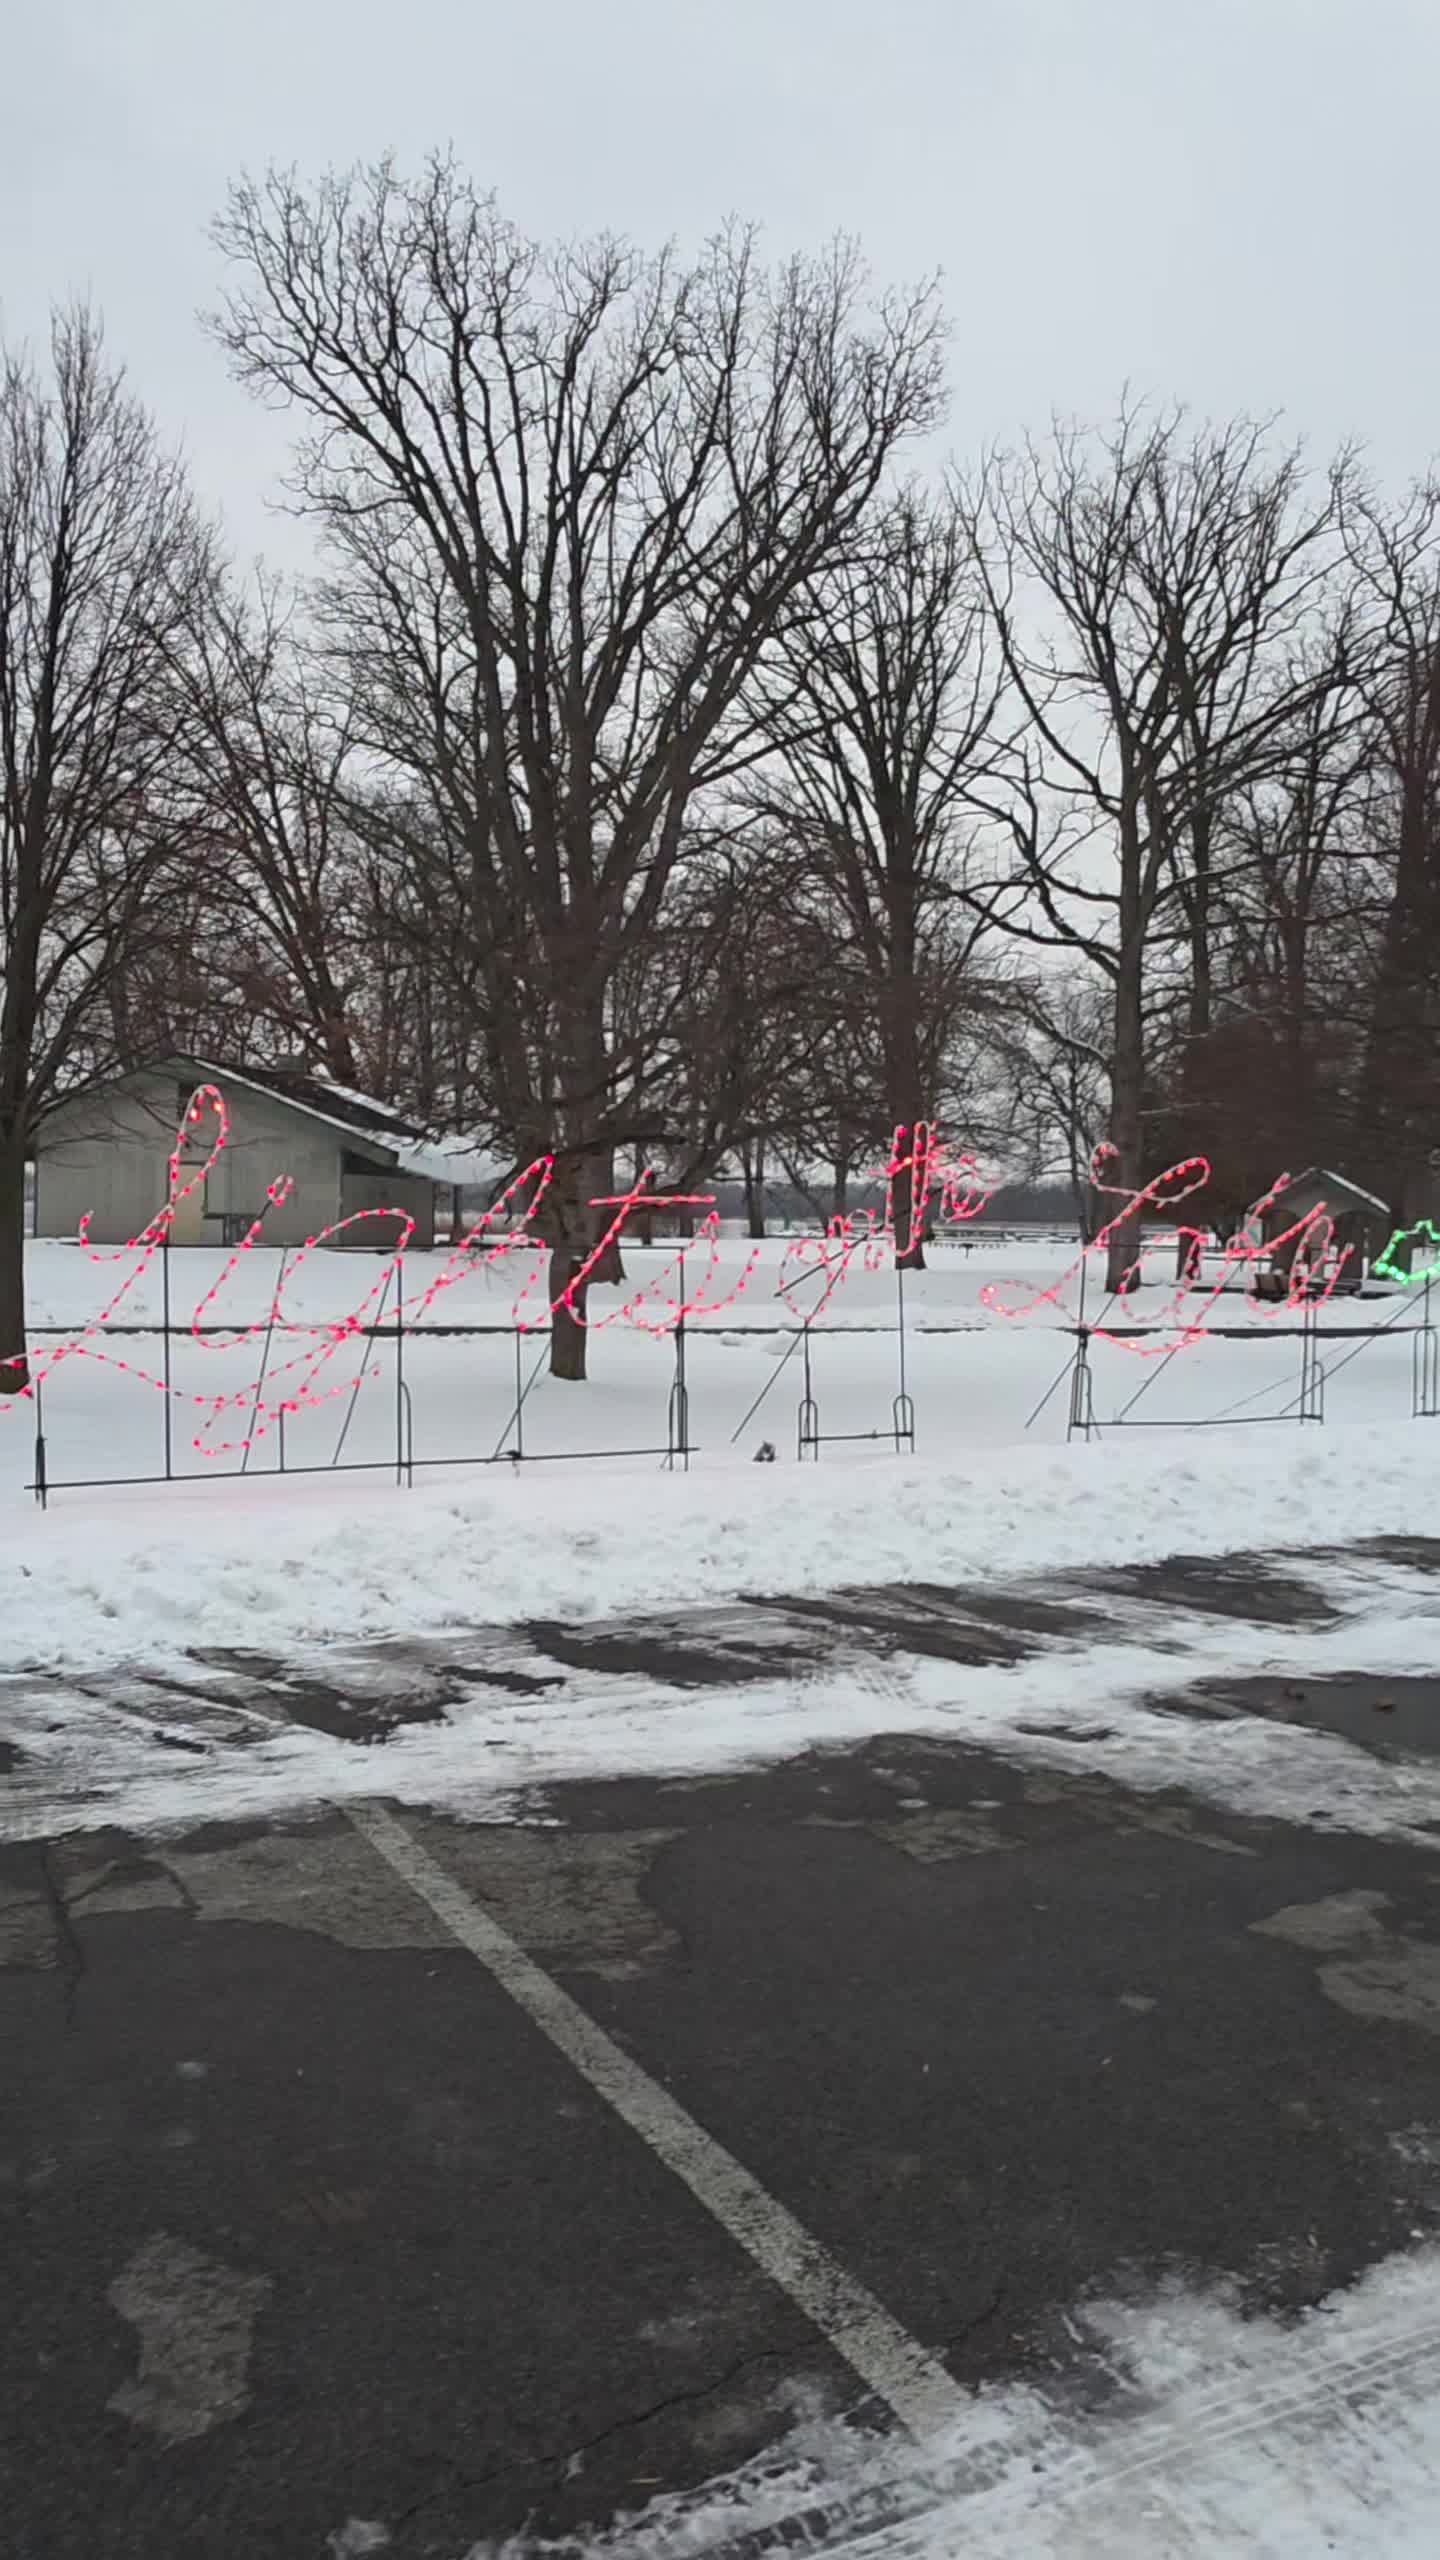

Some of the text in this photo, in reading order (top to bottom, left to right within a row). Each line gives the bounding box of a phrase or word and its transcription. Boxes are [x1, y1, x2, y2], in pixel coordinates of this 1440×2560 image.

[0, 1084, 761, 1455] Lights
[868, 1120, 1002, 1258] the
[979, 1141, 1354, 1357] Lake
